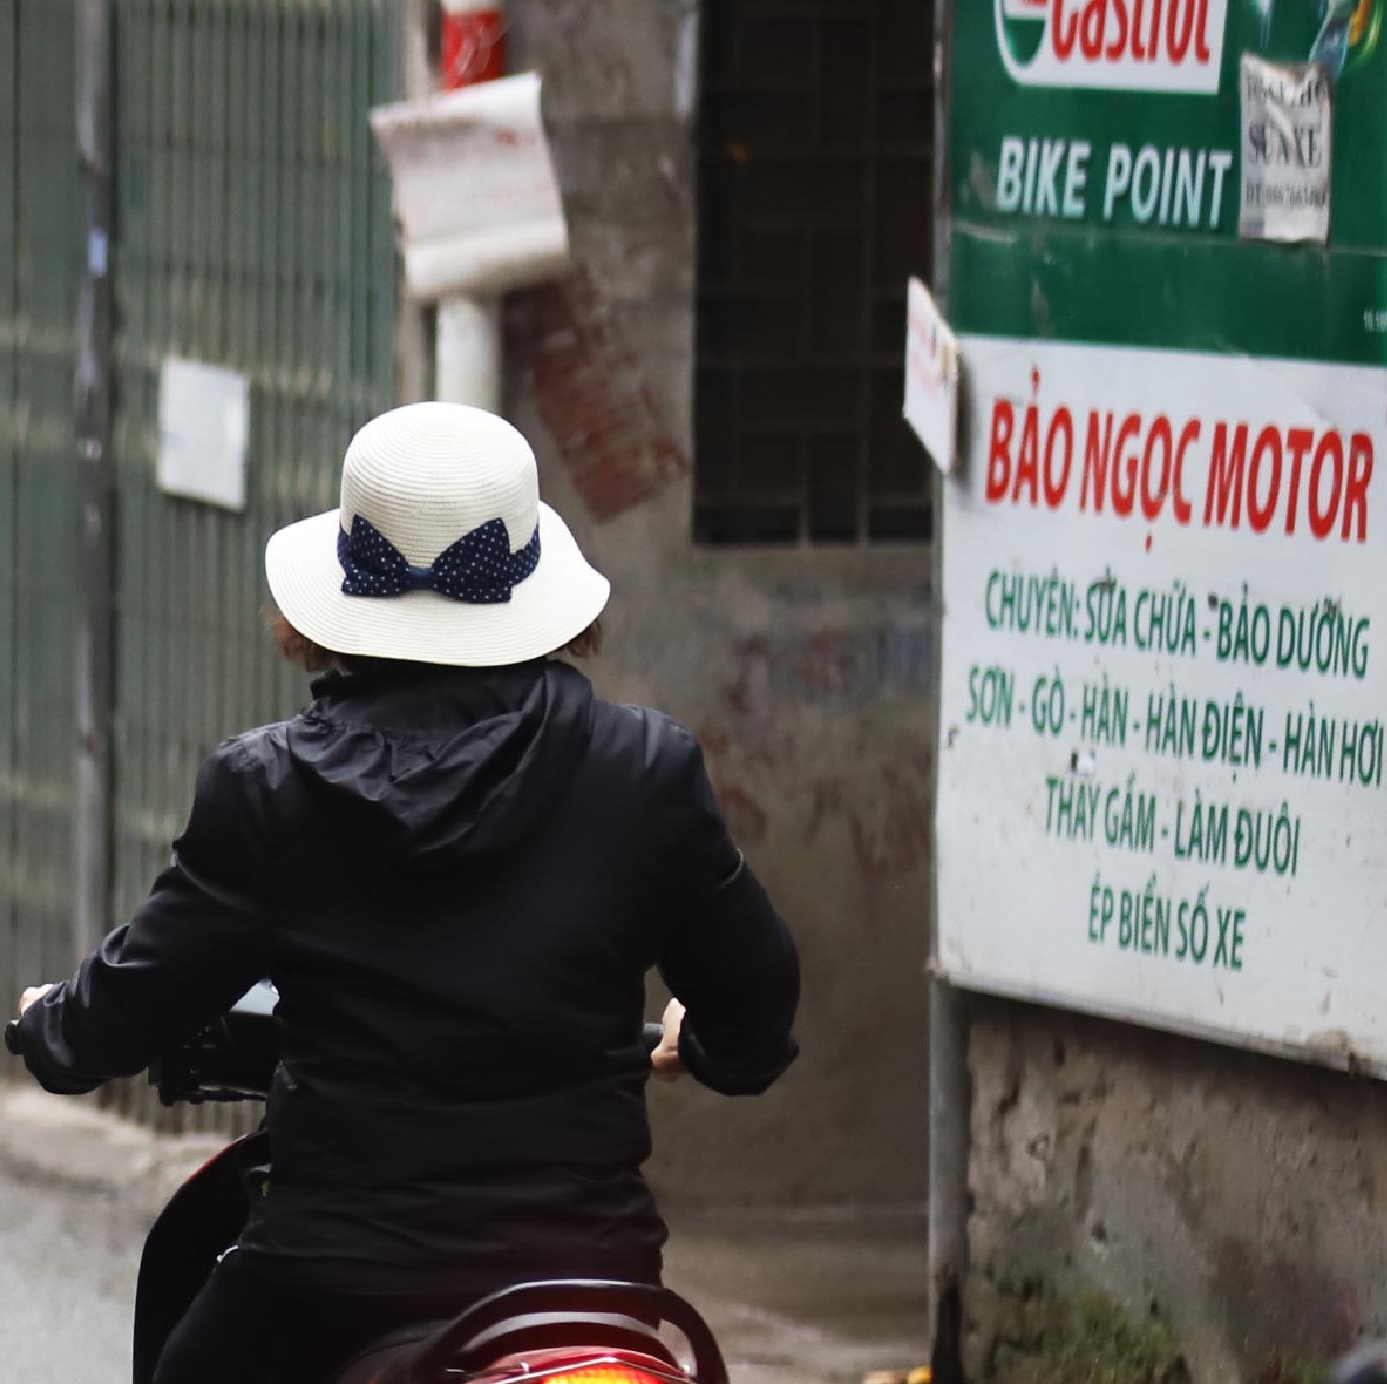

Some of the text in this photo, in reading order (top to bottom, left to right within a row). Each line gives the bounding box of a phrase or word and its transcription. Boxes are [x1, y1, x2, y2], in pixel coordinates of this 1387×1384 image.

[996, 135, 1233, 230] BIKE POINT
[985, 365, 1375, 554] BẢO NGỌC MOTOR
[1216, 582, 1270, 666] BẢO
[1080, 671, 1129, 747] HÀN
[1146, 682, 1197, 760] HÀN
[1202, 688, 1265, 784] ĐIỆN
[1282, 699, 1336, 780] HÀN
[1045, 774, 1101, 841] THAY
[1173, 789, 1228, 864] LÀM
[1233, 801, 1302, 876] ĐUÔI
[1087, 871, 1115, 944] ÉP
[1175, 882, 1211, 964] SỐ
[1213, 907, 1246, 971] XE
